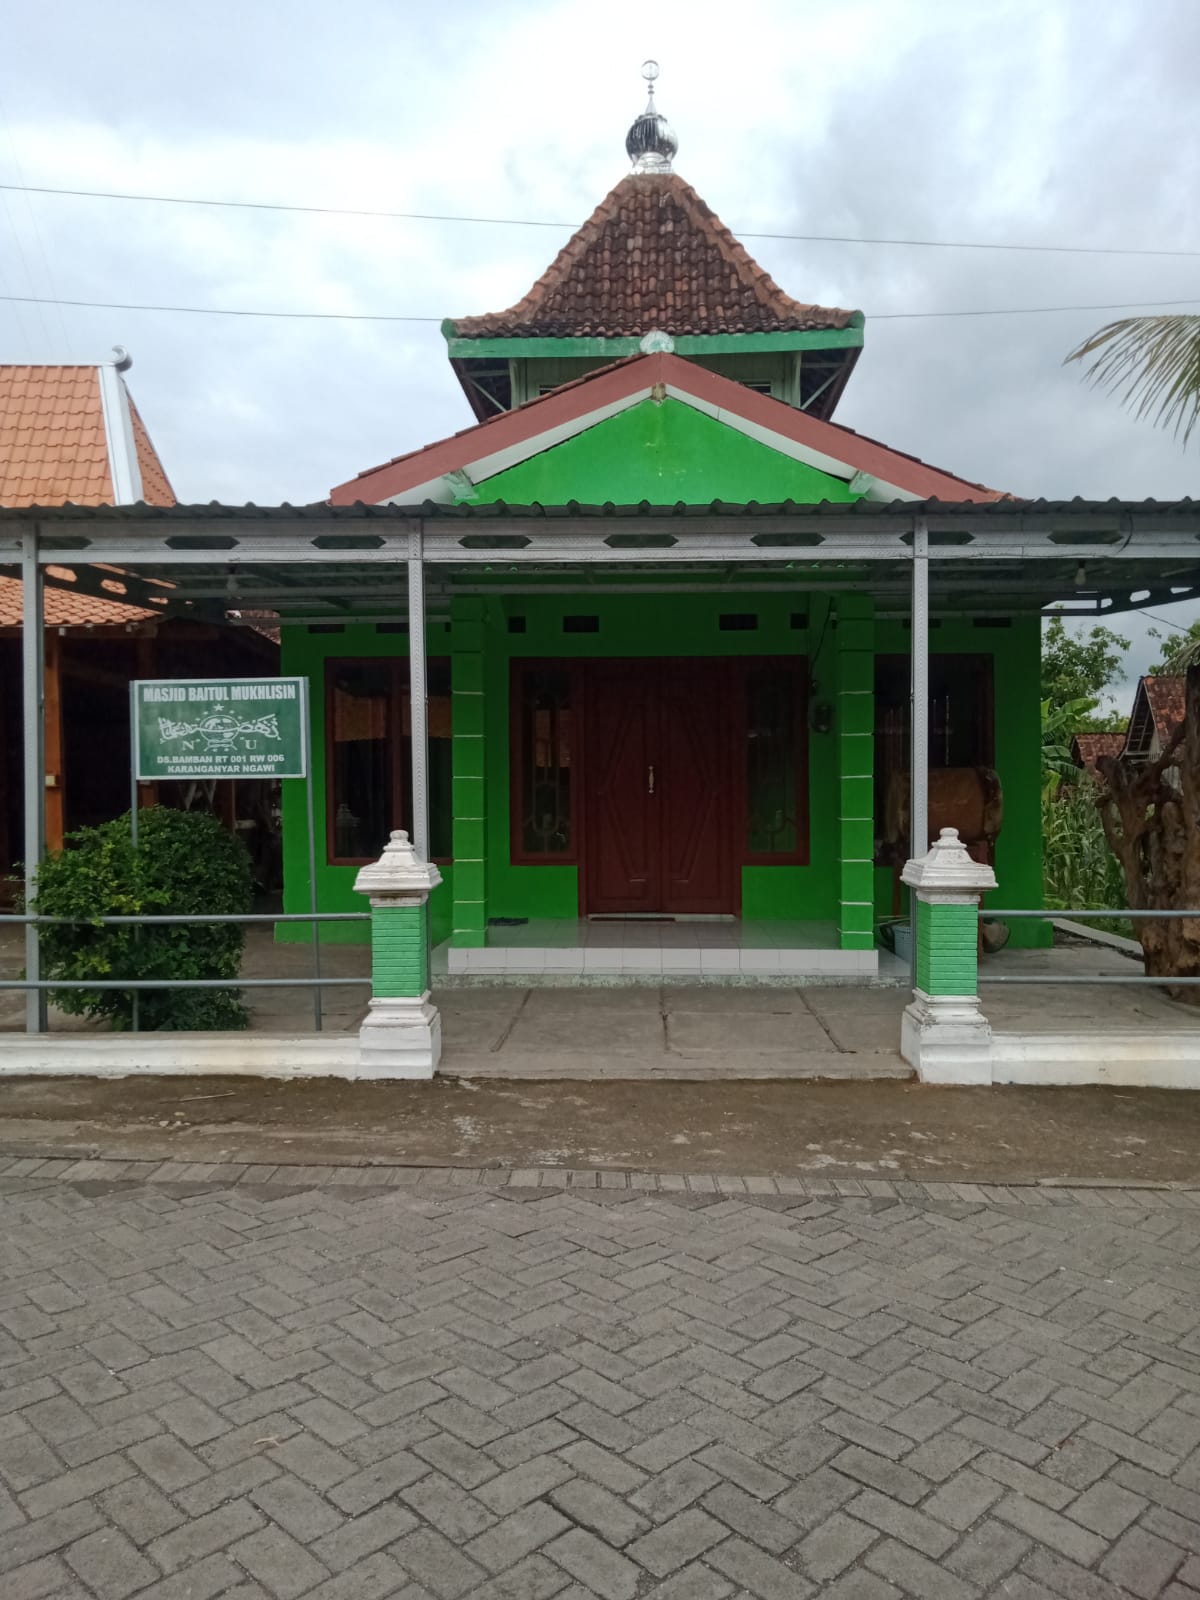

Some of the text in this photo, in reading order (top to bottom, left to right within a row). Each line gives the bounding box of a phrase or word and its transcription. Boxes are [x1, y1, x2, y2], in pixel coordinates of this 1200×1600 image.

[143, 685, 296, 702] MASJID BAITUL MUKHLISIN
[182, 740, 257, 751] N U
[215, 755, 228, 763] RT
[230, 755, 247, 763] 001
[250, 755, 266, 763] RW
[267, 754, 285, 762] 006
[167, 764, 276, 773] KARANGANYAR NGAWI
